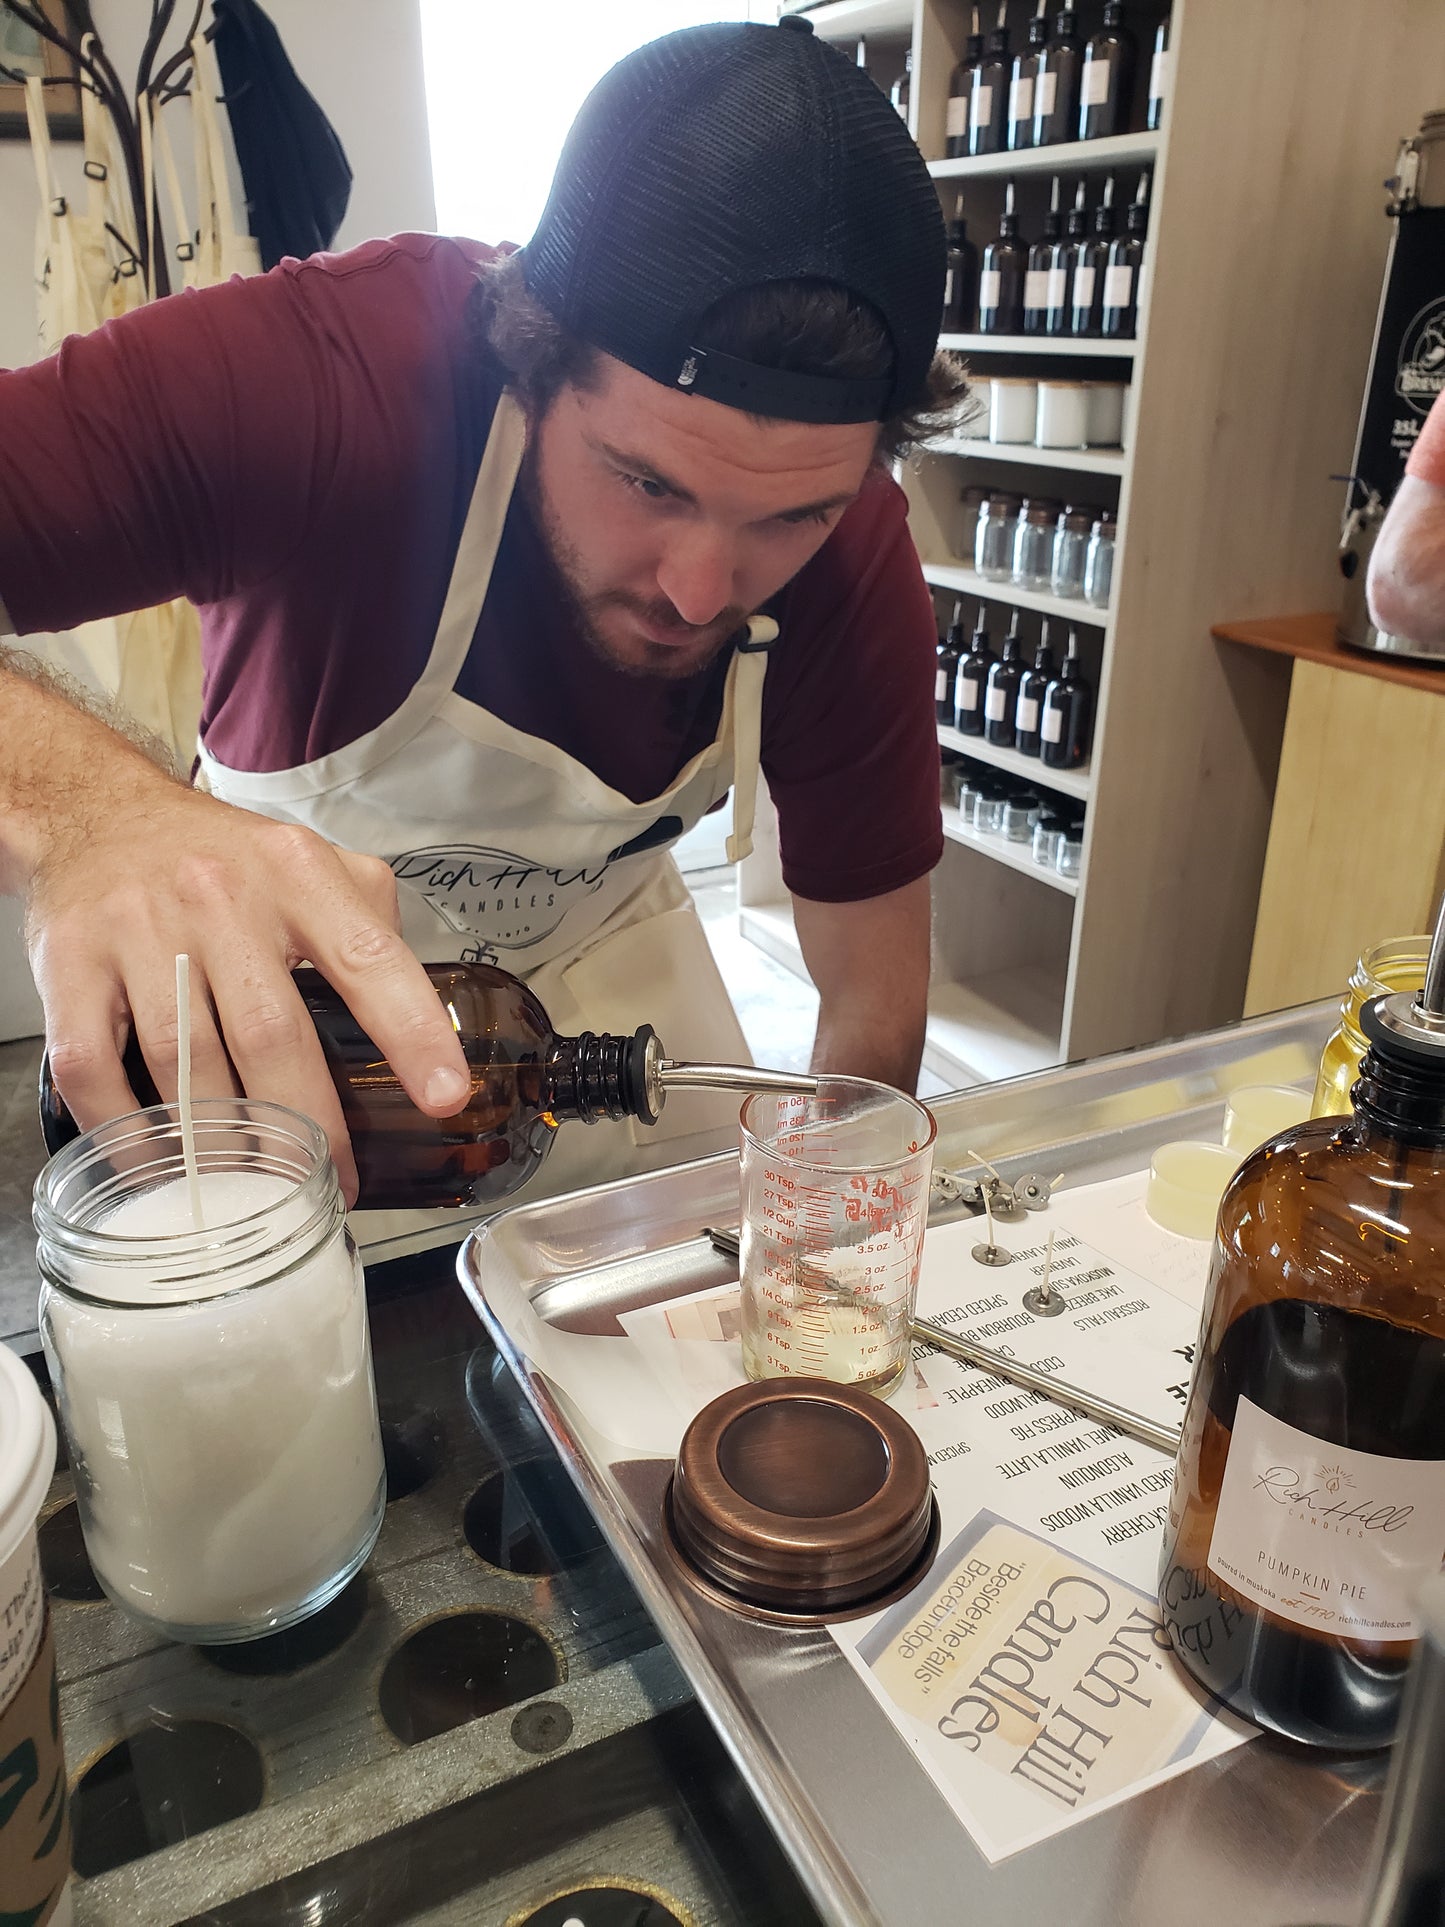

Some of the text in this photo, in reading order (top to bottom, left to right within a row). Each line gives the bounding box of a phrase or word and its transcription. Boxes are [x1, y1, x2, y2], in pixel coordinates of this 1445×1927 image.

[439, 894, 555, 914] CANDLES
[764, 1170, 775, 1182] 30
[764, 1188, 775, 1200] 27
[763, 1206, 774, 1218] 1/2
[763, 1226, 773, 1237] 21
[857, 1242, 890, 1254] 3.5 oz.
[763, 1266, 773, 1277] 15
[865, 1264, 888, 1276] 3 oz.
[1069, 1267, 1115, 1286] MUSKOKA
[761, 1287, 793, 1309] 1/4 Cup
[854, 1285, 873, 1295] 2.5
[1064, 1284, 1124, 1312] LAKE BREEZE
[767, 1310, 774, 1319] 9
[862, 1306, 869, 1315] 2
[928, 1294, 1008, 1328] SPICED CEDAR
[1073, 1299, 1150, 1332] ROSSEAU FALLS
[852, 1325, 868, 1335] 1.5
[976, 1312, 1035, 1338] BOURBON
[767, 1332, 792, 1351] 6 Tsp.
[860, 1346, 865, 1355] 1
[767, 1355, 792, 1374] 3 Tsp.
[855, 1371, 865, 1380] .5
[943, 1374, 1013, 1405] PINEAPPLE
[1010, 1407, 1088, 1442] CYPRESS FIG
[935, 1441, 972, 1464] SPICED
[1038, 1436, 1091, 1464] VANILLA
[995, 1454, 1040, 1480] LATTE
[1058, 1451, 1134, 1490] ALGONQUIN
[1090, 1482, 1148, 1514] VANILLA
[1252, 1466, 1415, 1532] Rich Hill
[1040, 1499, 1094, 1533] WOODS
[1288, 1508, 1364, 1538] CANDLES
[1100, 1513, 1158, 1546] CHERRY
[1257, 1550, 1368, 1600] PUMPKIN PIE
[1217, 1555, 1238, 1577] poured
[1238, 1569, 1247, 1582] in
[1246, 1577, 1277, 1600] muskoka
[1304, 1600, 1337, 1620] 1970
[1338, 1615, 1412, 1629] richhillcandles.com
[942, 1619, 978, 1648] the
[937, 1575, 1111, 1753] Candles
[1010, 1606, 1174, 1808] Rich Hill
